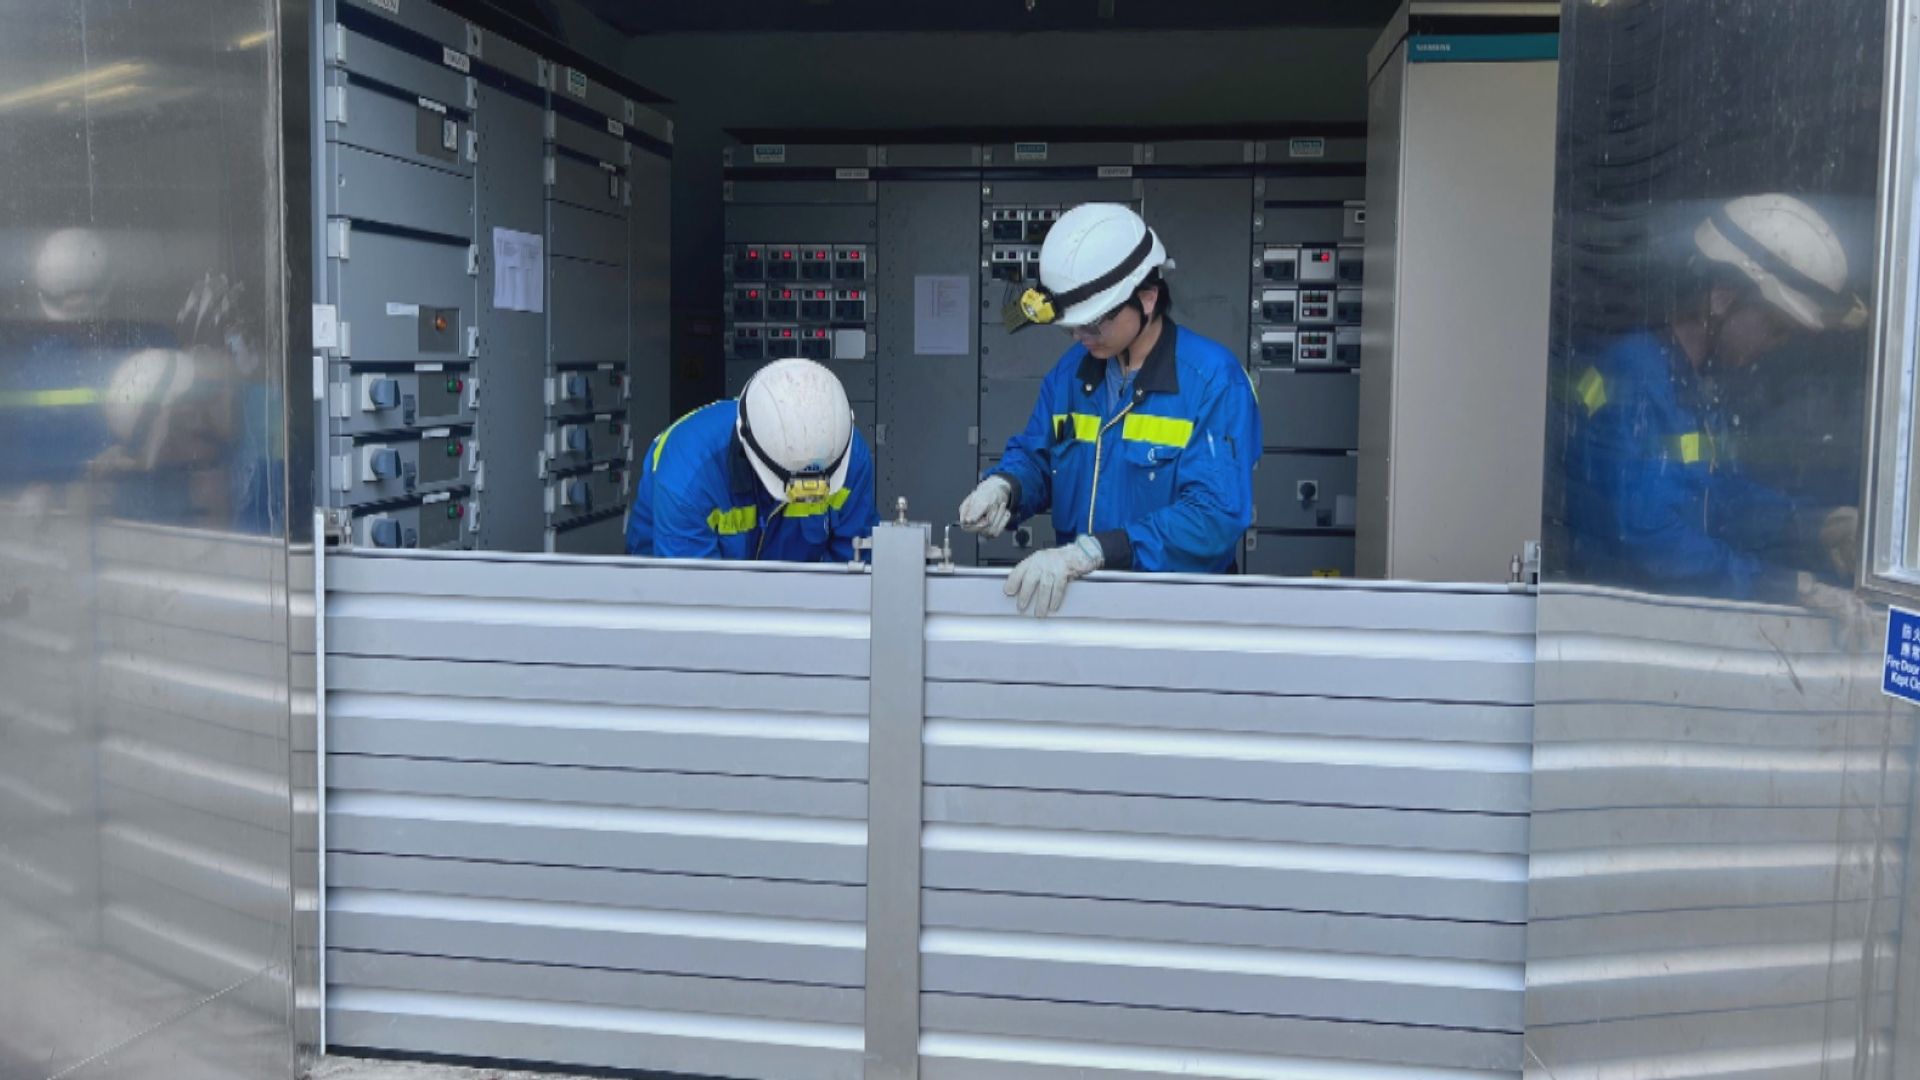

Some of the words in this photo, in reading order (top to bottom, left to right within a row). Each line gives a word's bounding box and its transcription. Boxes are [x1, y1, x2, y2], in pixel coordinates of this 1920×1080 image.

[1887, 654, 1900, 670] Fire
[1901, 659, 1919, 675] Door
[1891, 671, 1909, 687] Kept
